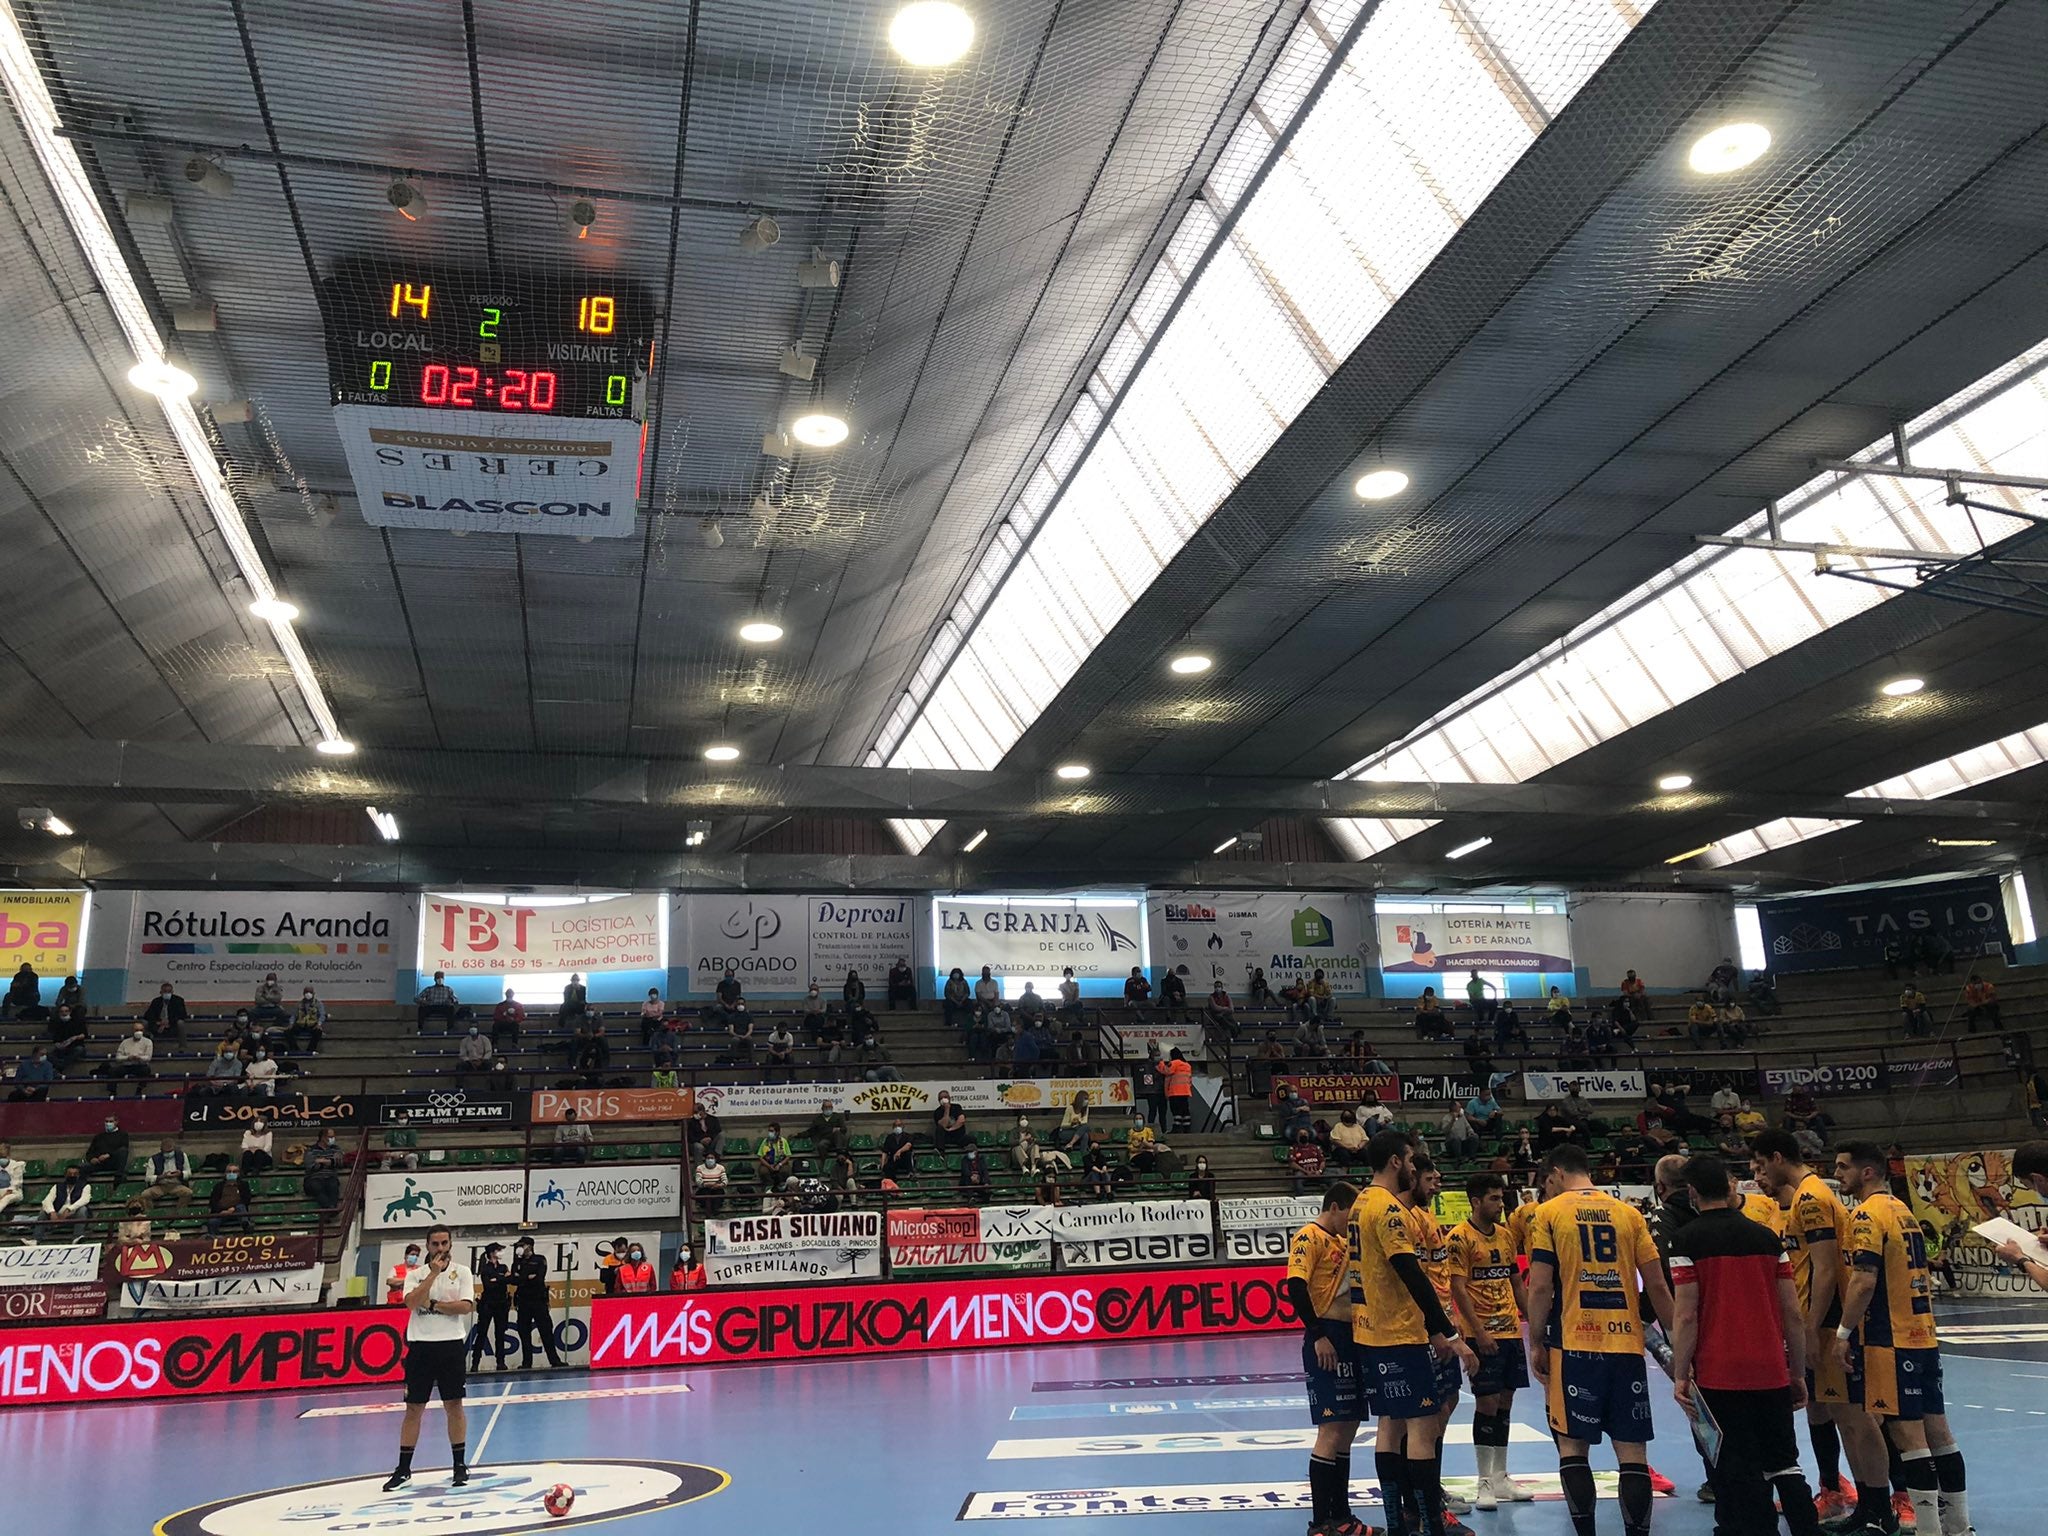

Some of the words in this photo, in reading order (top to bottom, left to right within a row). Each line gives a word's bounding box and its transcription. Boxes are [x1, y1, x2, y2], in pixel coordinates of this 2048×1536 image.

[390, 284, 431, 319] 14
[479, 308, 500, 338] 2
[580, 296, 615, 334] 18
[356, 330, 431, 352] LOCAL
[546, 342, 618, 364] VISITANTE
[370, 360, 392, 390] 0
[421, 364, 556, 410] 02:20
[606, 375, 626, 404] 0
[348, 392, 388, 404] FALTAS
[586, 405, 624, 418] FALTAS
[376, 447, 609, 477] CERES
[3, 896, 71, 904] INMOBILIARIA
[818, 902, 906, 928] Deproal
[1164, 904, 1216, 921] BigMat
[1848, 901, 1994, 935] TASIO
[142, 910, 265, 937] Rótulos
[274, 910, 390, 937] Aranda
[431, 904, 536, 952] TBT
[552, 915, 634, 934] LOGÍSTICA
[645, 914, 656, 926] Y
[941, 910, 974, 931] LA
[984, 912, 1090, 933] GRANJA
[1447, 918, 1492, 929] LOTERÍA
[1496, 920, 1531, 930] MAYTE
[552, 932, 657, 952] TRANSPORTE
[812, 932, 858, 940] CONTROL
[861, 932, 874, 940] DE
[876, 932, 910, 940] PLAGAS
[1449, 936, 1463, 944] LA
[1465, 936, 1472, 944] 3
[1474, 936, 1488, 944] DE
[1490, 936, 1532, 945] ARANDA
[1039, 942, 1054, 952] DE
[1058, 942, 1095, 952] CHICO
[166, 960, 206, 972] Centro
[209, 960, 284, 974] Especializado
[287, 960, 302, 971] de
[304, 960, 362, 971] Rotulación
[438, 959, 457, 968] Tel.
[462, 959, 485, 968] 636
[490, 959, 506, 968] 84
[510, 958, 526, 968] 59
[530, 958, 543, 968] 15
[558, 956, 598, 968] Aranda
[602, 955, 616, 964] de
[620, 953, 654, 963] Duero
[698, 956, 797, 972] ABOGADO
[835, 963, 854, 972] 947
[857, 963, 869, 972] 50
[872, 963, 885, 972] 96
[984, 963, 1046, 972] CALIDAD
[1050, 964, 1098, 972] DUROC
[1270, 954, 1360, 970] AlfaAranda
[1446, 958, 1488, 967] ¡HACIENDO
[1488, 958, 1540, 967] MILLONARIOS!
[1270, 971, 1362, 980] INMOBIARIA
[1118, 1030, 1188, 1038] WEIMAR
[1888, 1059, 1954, 1073] ROTULACIÓN
[1050, 1080, 1079, 1088] FRUTOS
[1079, 1079, 1103, 1088] SECOS
[1299, 1076, 1392, 1088] BRASA-AWAY
[1416, 1076, 1435, 1085] New
[1765, 1066, 1834, 1086] ESTUDIO
[1838, 1065, 1878, 1081] 1200
[727, 1087, 745, 1096] Bar
[748, 1086, 810, 1095] Restaurante
[812, 1085, 845, 1095] Trasgu
[1403, 1081, 1441, 1100] Prado
[1552, 1076, 1616, 1094] TeFriVe,
[1620, 1076, 1642, 1092] s.l.
[854, 1084, 930, 1105] PANADERIA
[190, 1105, 208, 1122] el
[218, 1095, 354, 1122] somatén
[455, 1106, 502, 1116] TEAM
[538, 1091, 620, 1118] PARÍS
[870, 1096, 912, 1112] SANZ
[300, 1119, 321, 1128] tapas
[457, 1182, 523, 1196] INMOBICORP
[576, 1178, 660, 1197] ARANCORP,
[458, 1198, 483, 1207] Gestión
[484, 1196, 521, 1206] Inmobiliaria
[624, 1196, 636, 1205] de
[638, 1195, 671, 1206] seguros
[1058, 1206, 1136, 1229] Carmelo
[1141, 1204, 1204, 1222] Rodero
[1222, 1206, 1320, 1221] MONTOUTO
[1575, 1208, 1612, 1223] JUANDE
[729, 1218, 782, 1243] CASA
[790, 1214, 878, 1238] SILVIANO
[890, 1218, 970, 1236] Microsshop
[985, 1219, 1052, 1238] AJAX
[212, 1235, 276, 1250] LUCIO
[760, 1241, 793, 1251] RACIONES
[801, 1239, 841, 1248] BOCADILLOS
[848, 1239, 878, 1247] PINCHOS
[1576, 1223, 1617, 1263] 18
[191, 1250, 253, 1265] MOZO,
[260, 1247, 294, 1260] S.L.
[894, 1243, 987, 1266] BACALAO
[1946, 1246, 2008, 1267] RANDA
[66, 1267, 92, 1278] Bar
[177, 1268, 194, 1276] Tfno
[195, 1268, 209, 1276] 947
[220, 1265, 230, 1274] 98
[246, 1262, 272, 1271] Aranda
[273, 1261, 283, 1269] de
[284, 1260, 306, 1268] Duero
[713, 1260, 828, 1282] TORREMILANOS
[591, 1299, 712, 1360] MÁS
[715, 1298, 928, 1354] GIPUZKOA
[927, 1288, 1095, 1340] MENOS
[1608, 1321, 1632, 1332] 016
[1383, 1384, 1412, 1399] CERES
[327, 1506, 548, 1532] asoba
